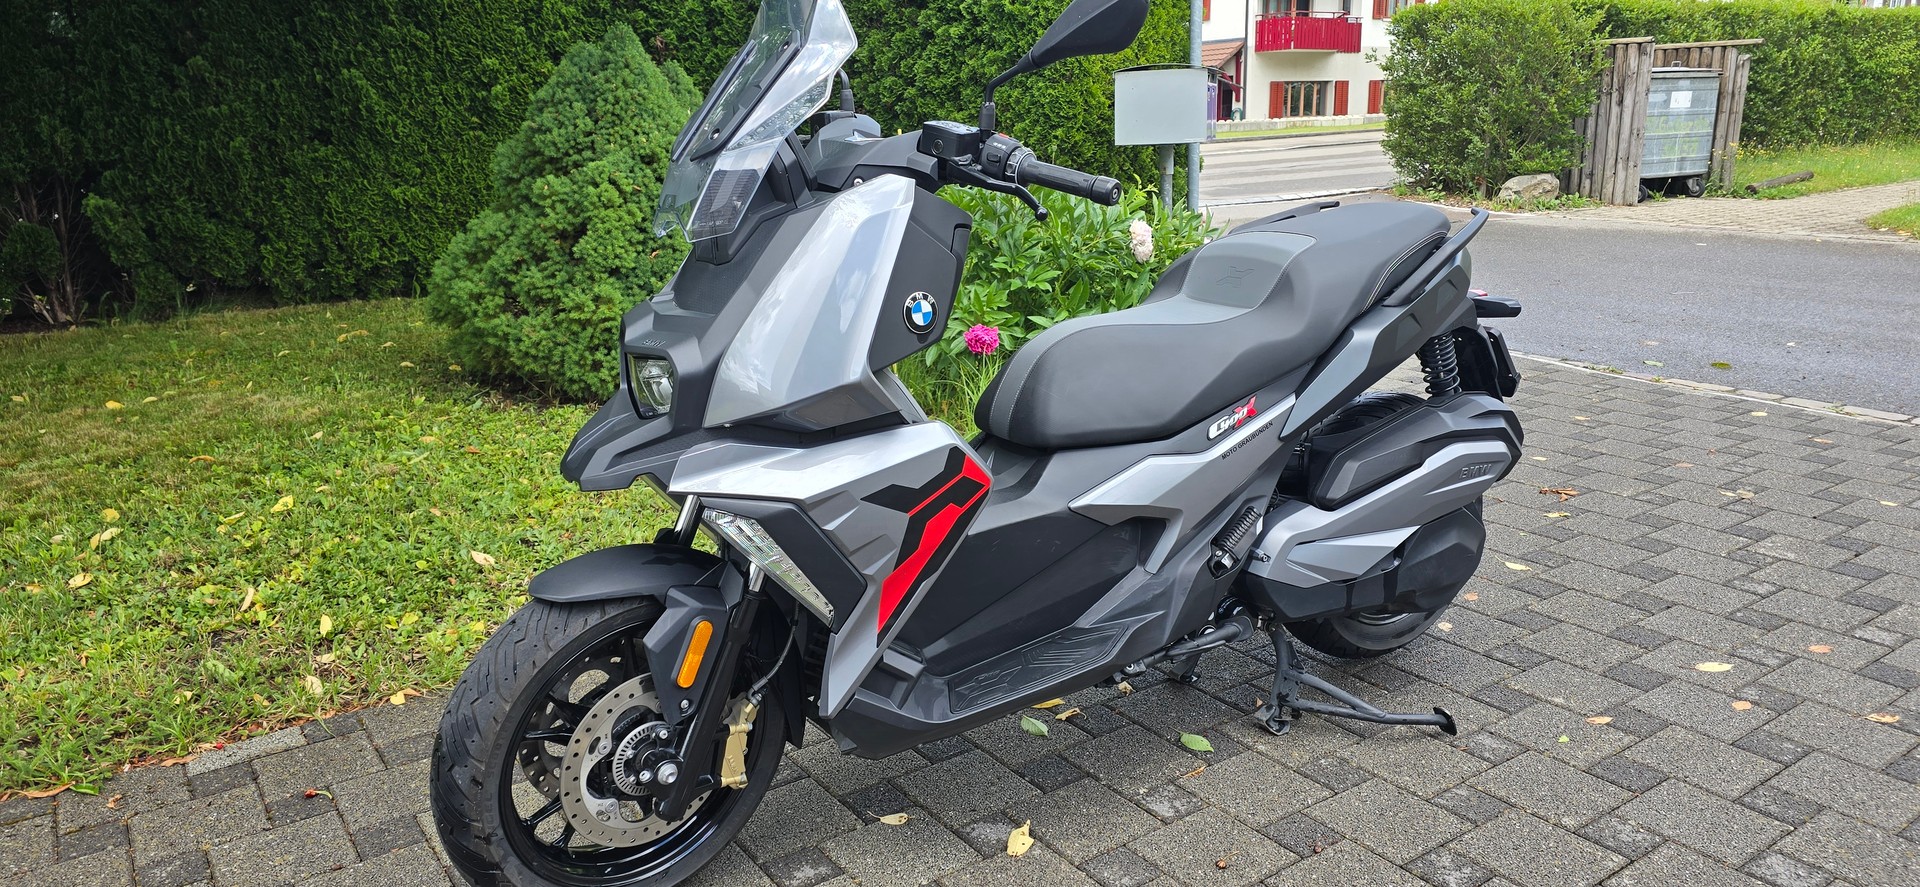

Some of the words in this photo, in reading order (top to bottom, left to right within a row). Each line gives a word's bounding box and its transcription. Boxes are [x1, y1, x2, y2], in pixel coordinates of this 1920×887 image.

[906, 292, 935, 308] BMW
[1221, 446, 1238, 461] MOTO
[1459, 463, 1493, 479] BMW
